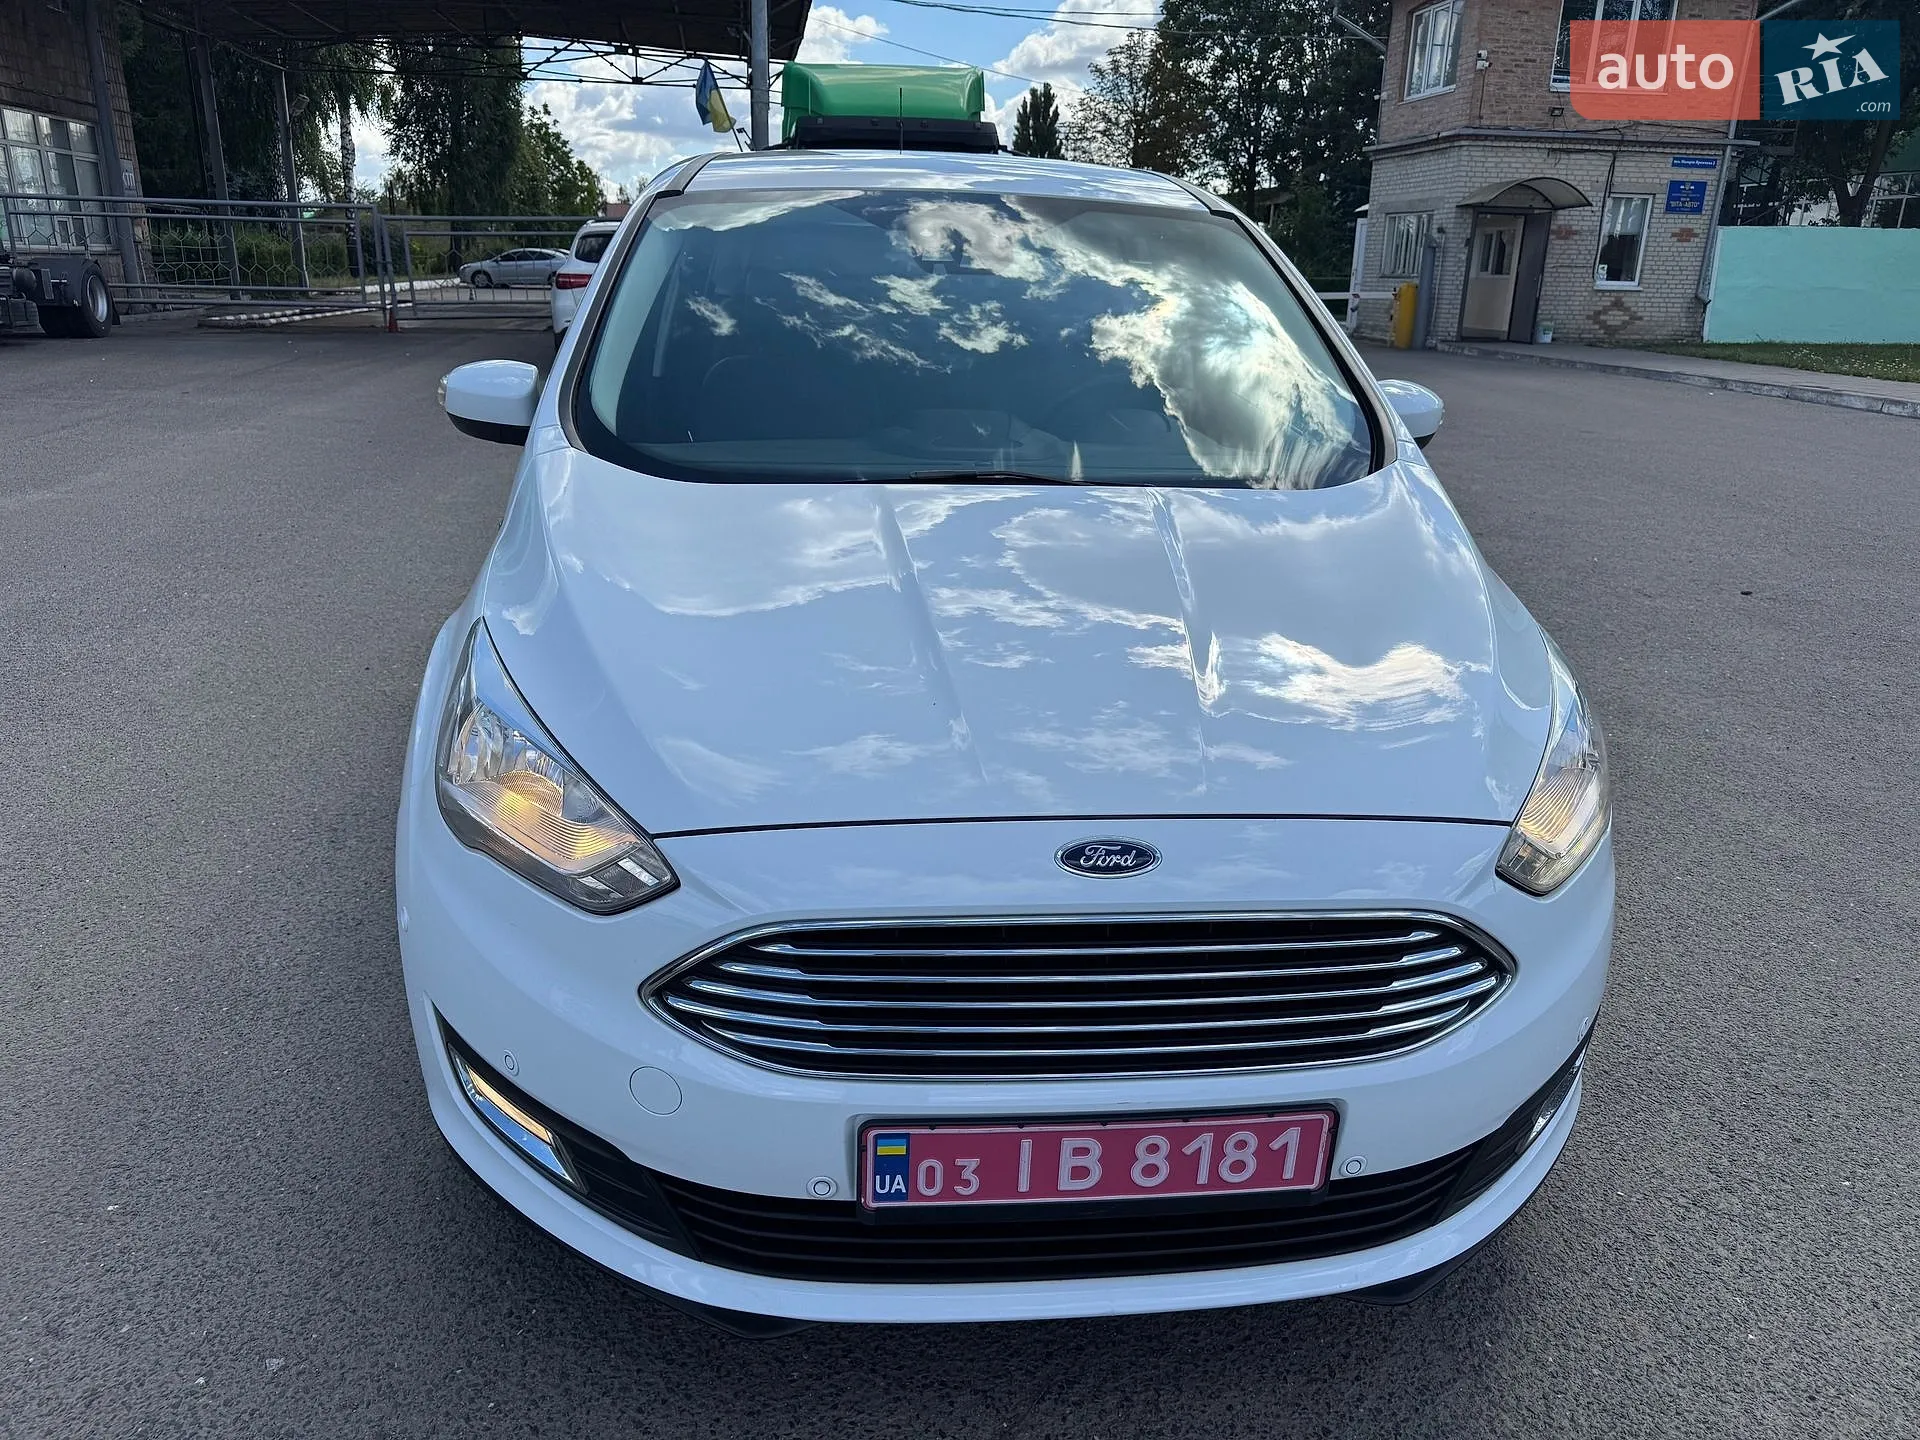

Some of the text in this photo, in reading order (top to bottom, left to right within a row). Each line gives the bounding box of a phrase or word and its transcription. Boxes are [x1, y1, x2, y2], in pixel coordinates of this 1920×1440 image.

[1080, 845, 1137, 867] Ford
[875, 1127, 1301, 1196] UA 03 IB 8181
